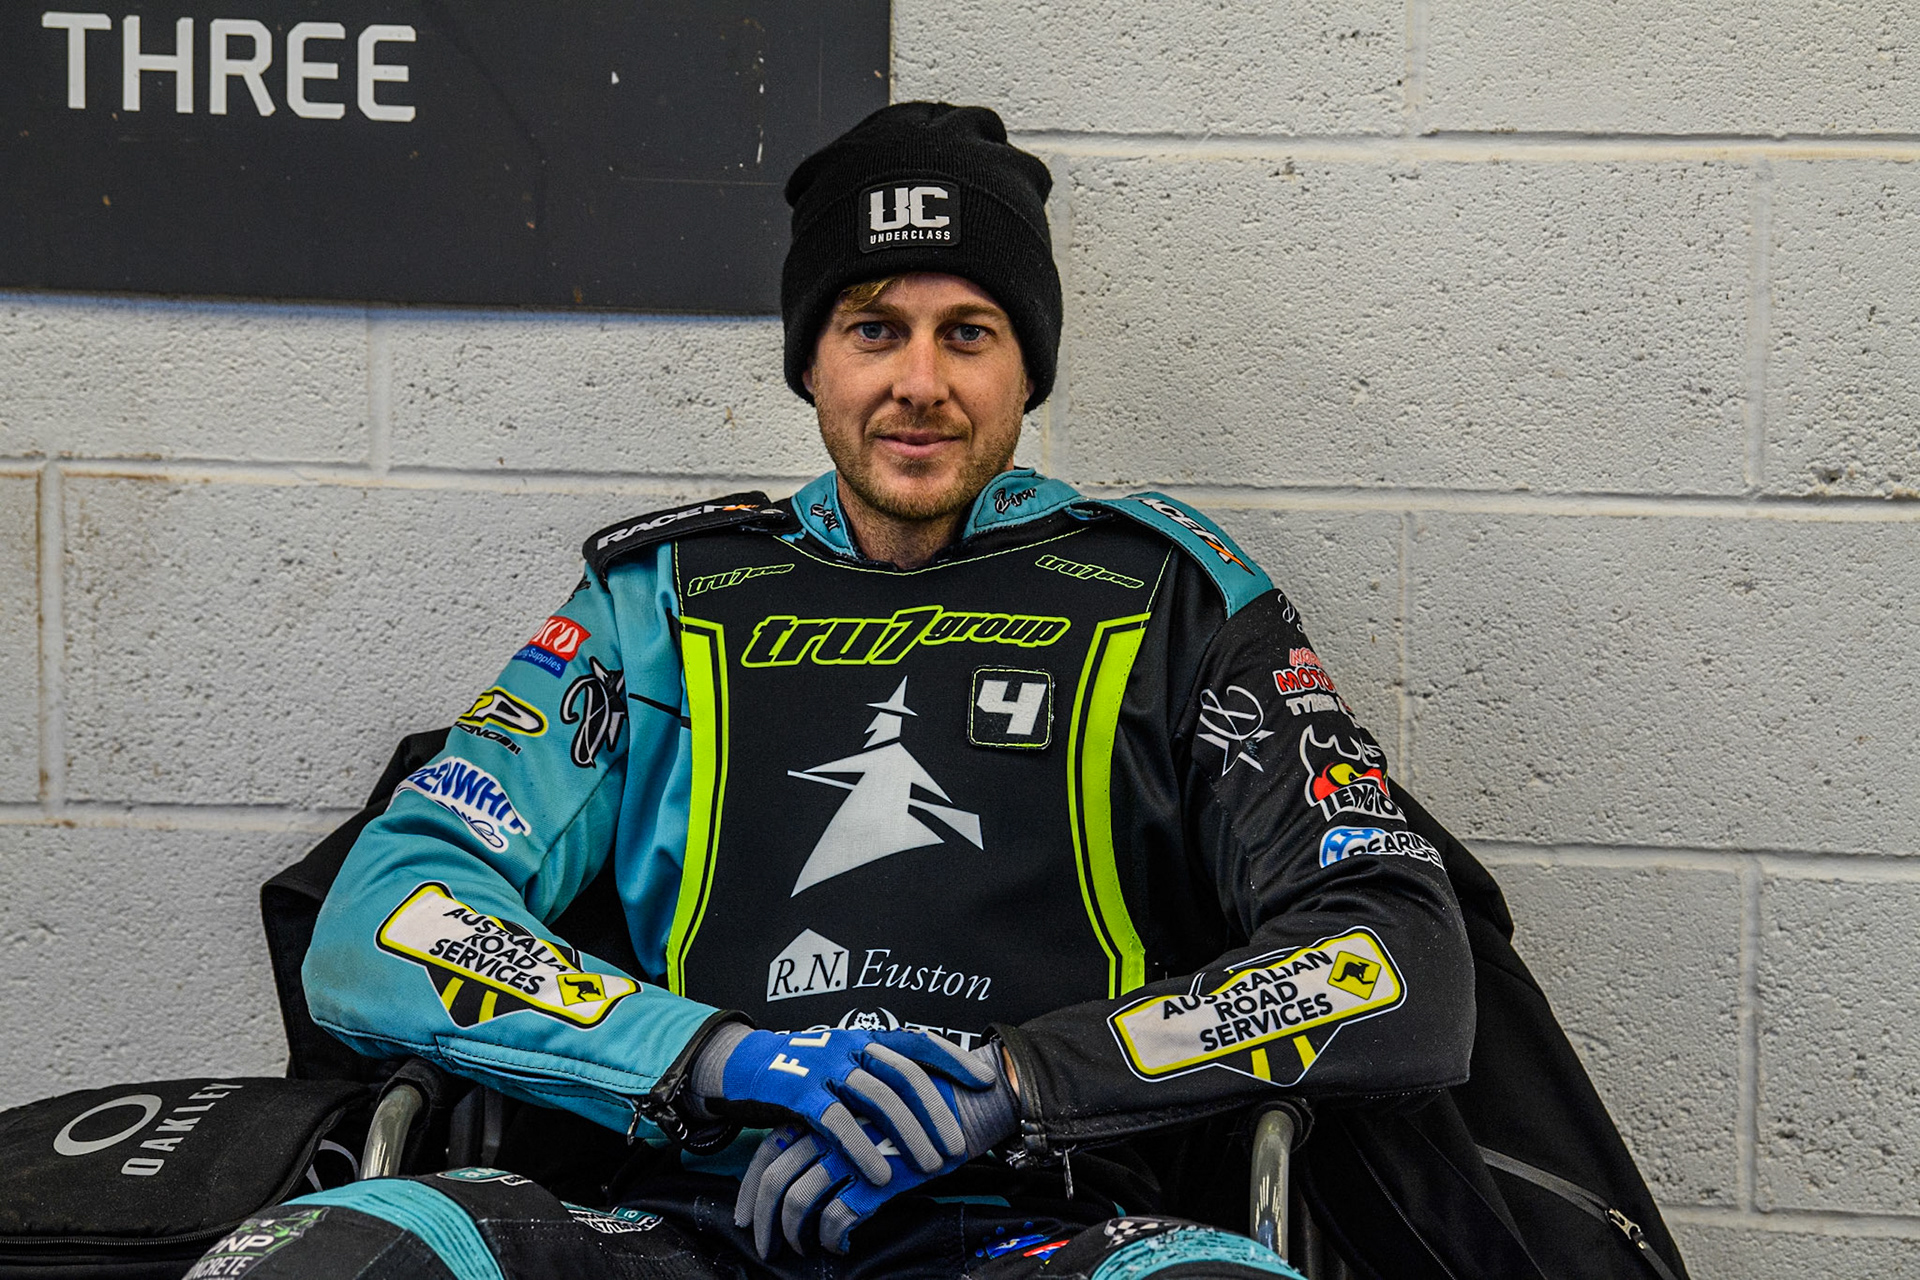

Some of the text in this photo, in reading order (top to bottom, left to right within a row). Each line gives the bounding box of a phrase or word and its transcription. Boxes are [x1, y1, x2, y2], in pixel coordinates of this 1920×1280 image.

[42, 11, 417, 122] THREE
[868, 186, 950, 232] UC
[870, 230, 951, 244] UNDERCLASS
[976, 679, 1048, 736] 4
[429, 938, 546, 996] SERVICES
[462, 932, 538, 970] ROAD
[768, 948, 993, 1001] R.N. Euston
[1200, 993, 1333, 1052] SERVICES
[1214, 981, 1299, 1023] ROAD
[120, 1083, 244, 1177] OAKLEY
